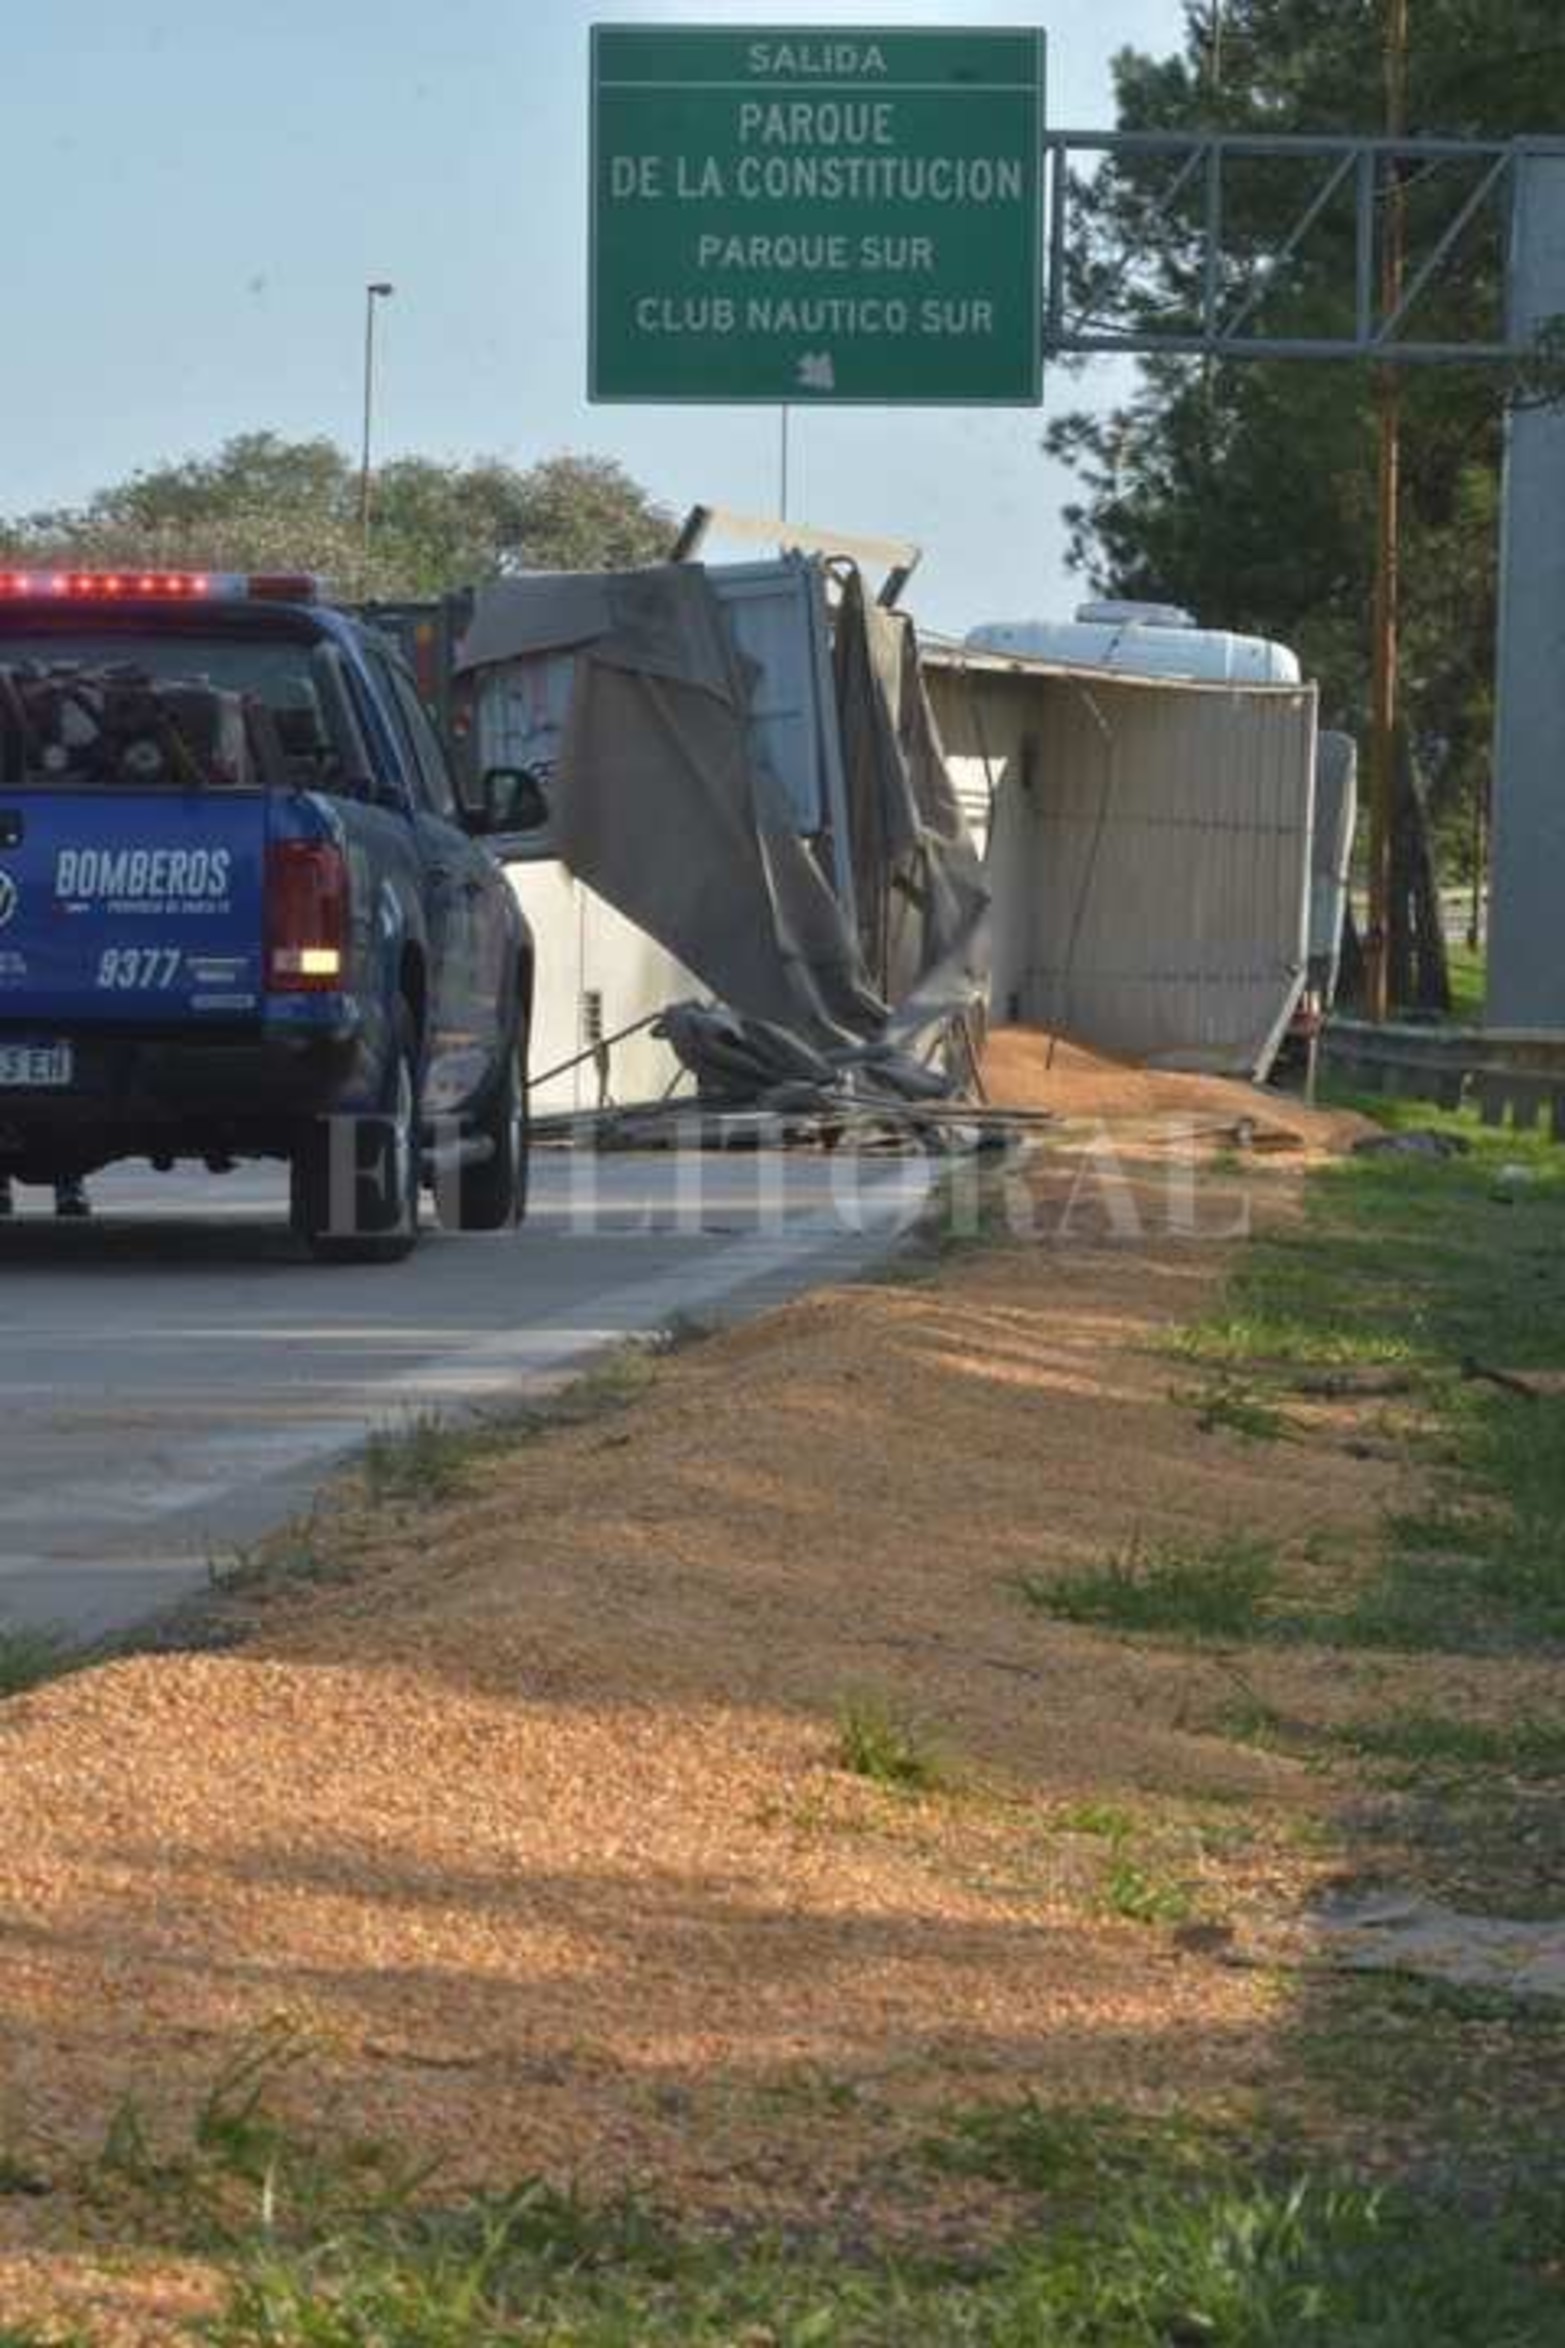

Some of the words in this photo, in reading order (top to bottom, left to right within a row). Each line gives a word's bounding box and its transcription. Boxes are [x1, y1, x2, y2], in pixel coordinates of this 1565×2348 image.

[747, 44, 887, 73] SALIDA
[738, 103, 893, 145] PARQUE
[611, 156, 662, 197] DE
[677, 156, 724, 198] LA
[737, 156, 1021, 200] CONSTITUCION
[698, 235, 848, 269] PARQUE
[860, 236, 934, 270] SUR
[636, 298, 735, 332] CLUB
[747, 299, 907, 332] NAUTICO
[921, 300, 993, 334] SUR
[55, 849, 231, 896] BOMBEROS
[97, 948, 182, 989] 9377
